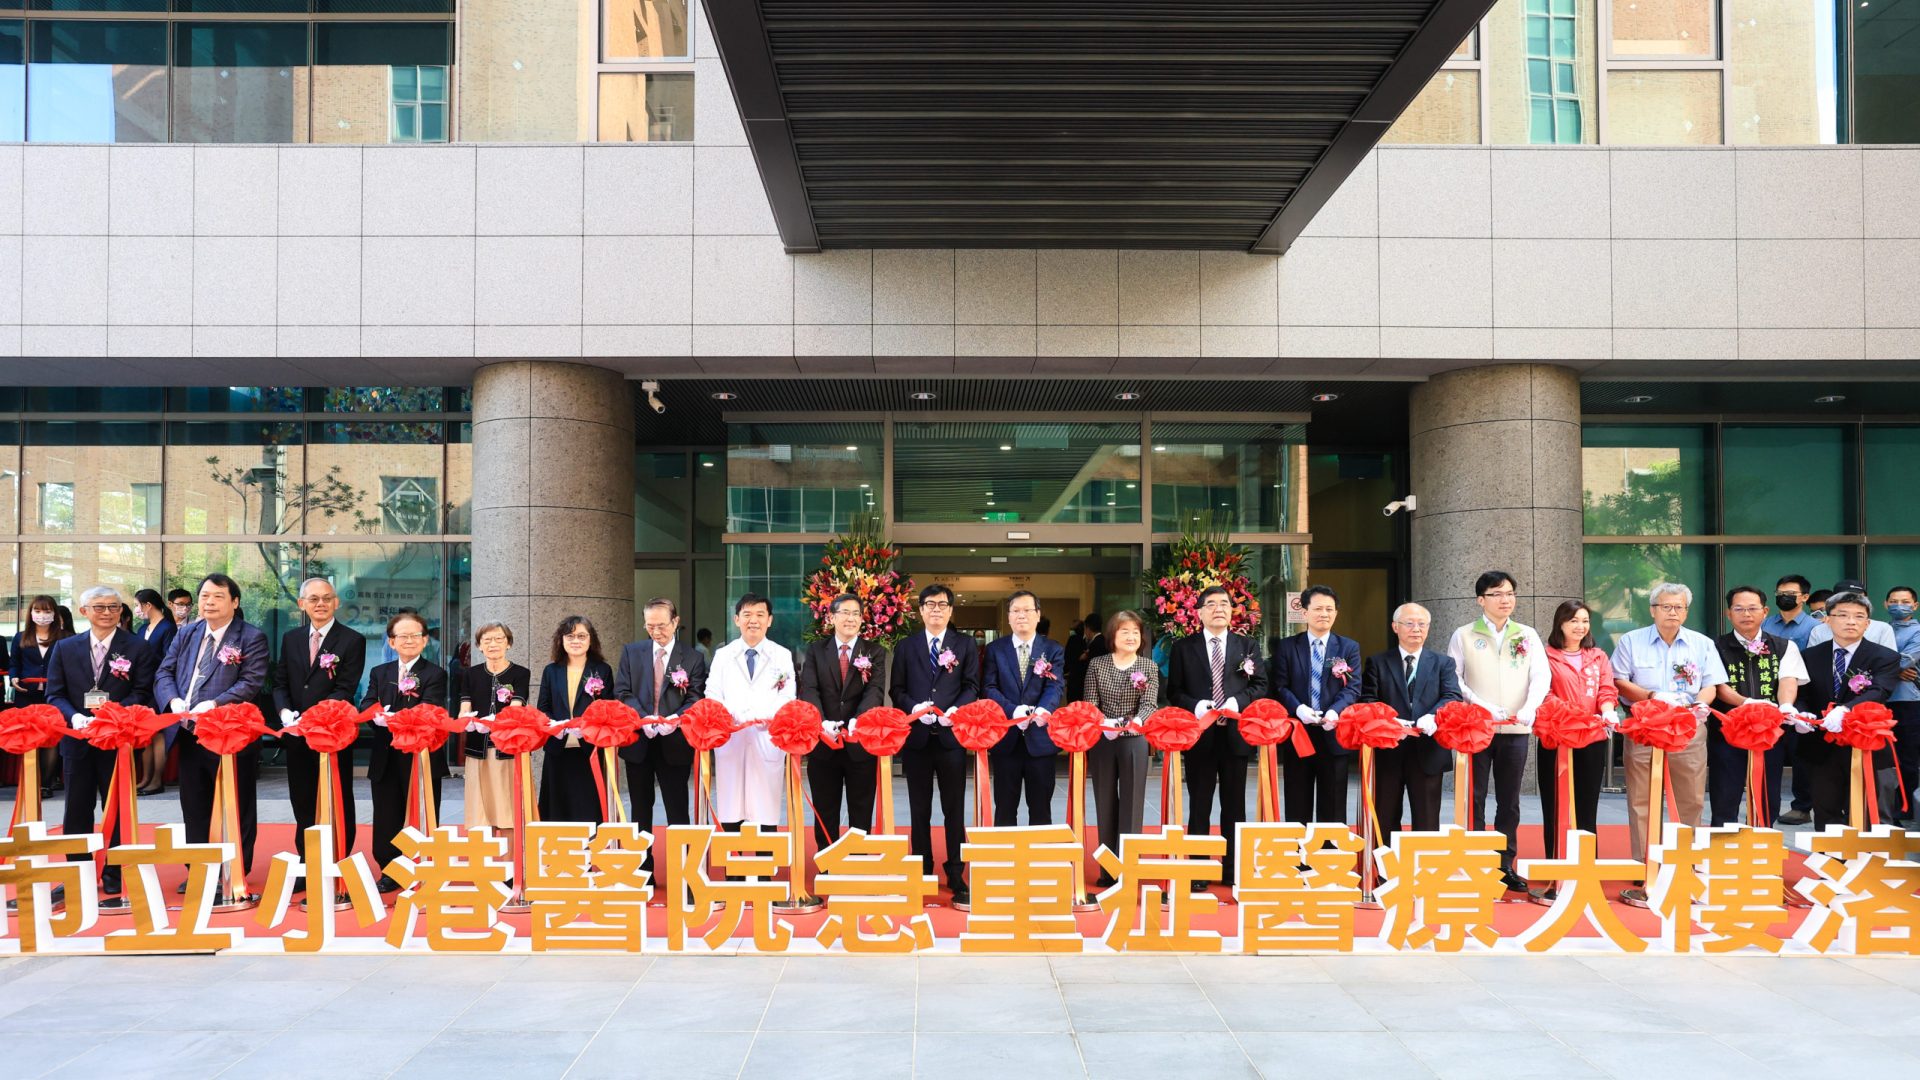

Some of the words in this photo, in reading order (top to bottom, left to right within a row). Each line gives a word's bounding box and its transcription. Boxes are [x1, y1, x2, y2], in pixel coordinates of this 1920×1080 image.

[1758, 657, 1774, 696] 賴瑞隆
[0, 821, 1920, 954] 市立小港醫院急重症醫療大樓落
